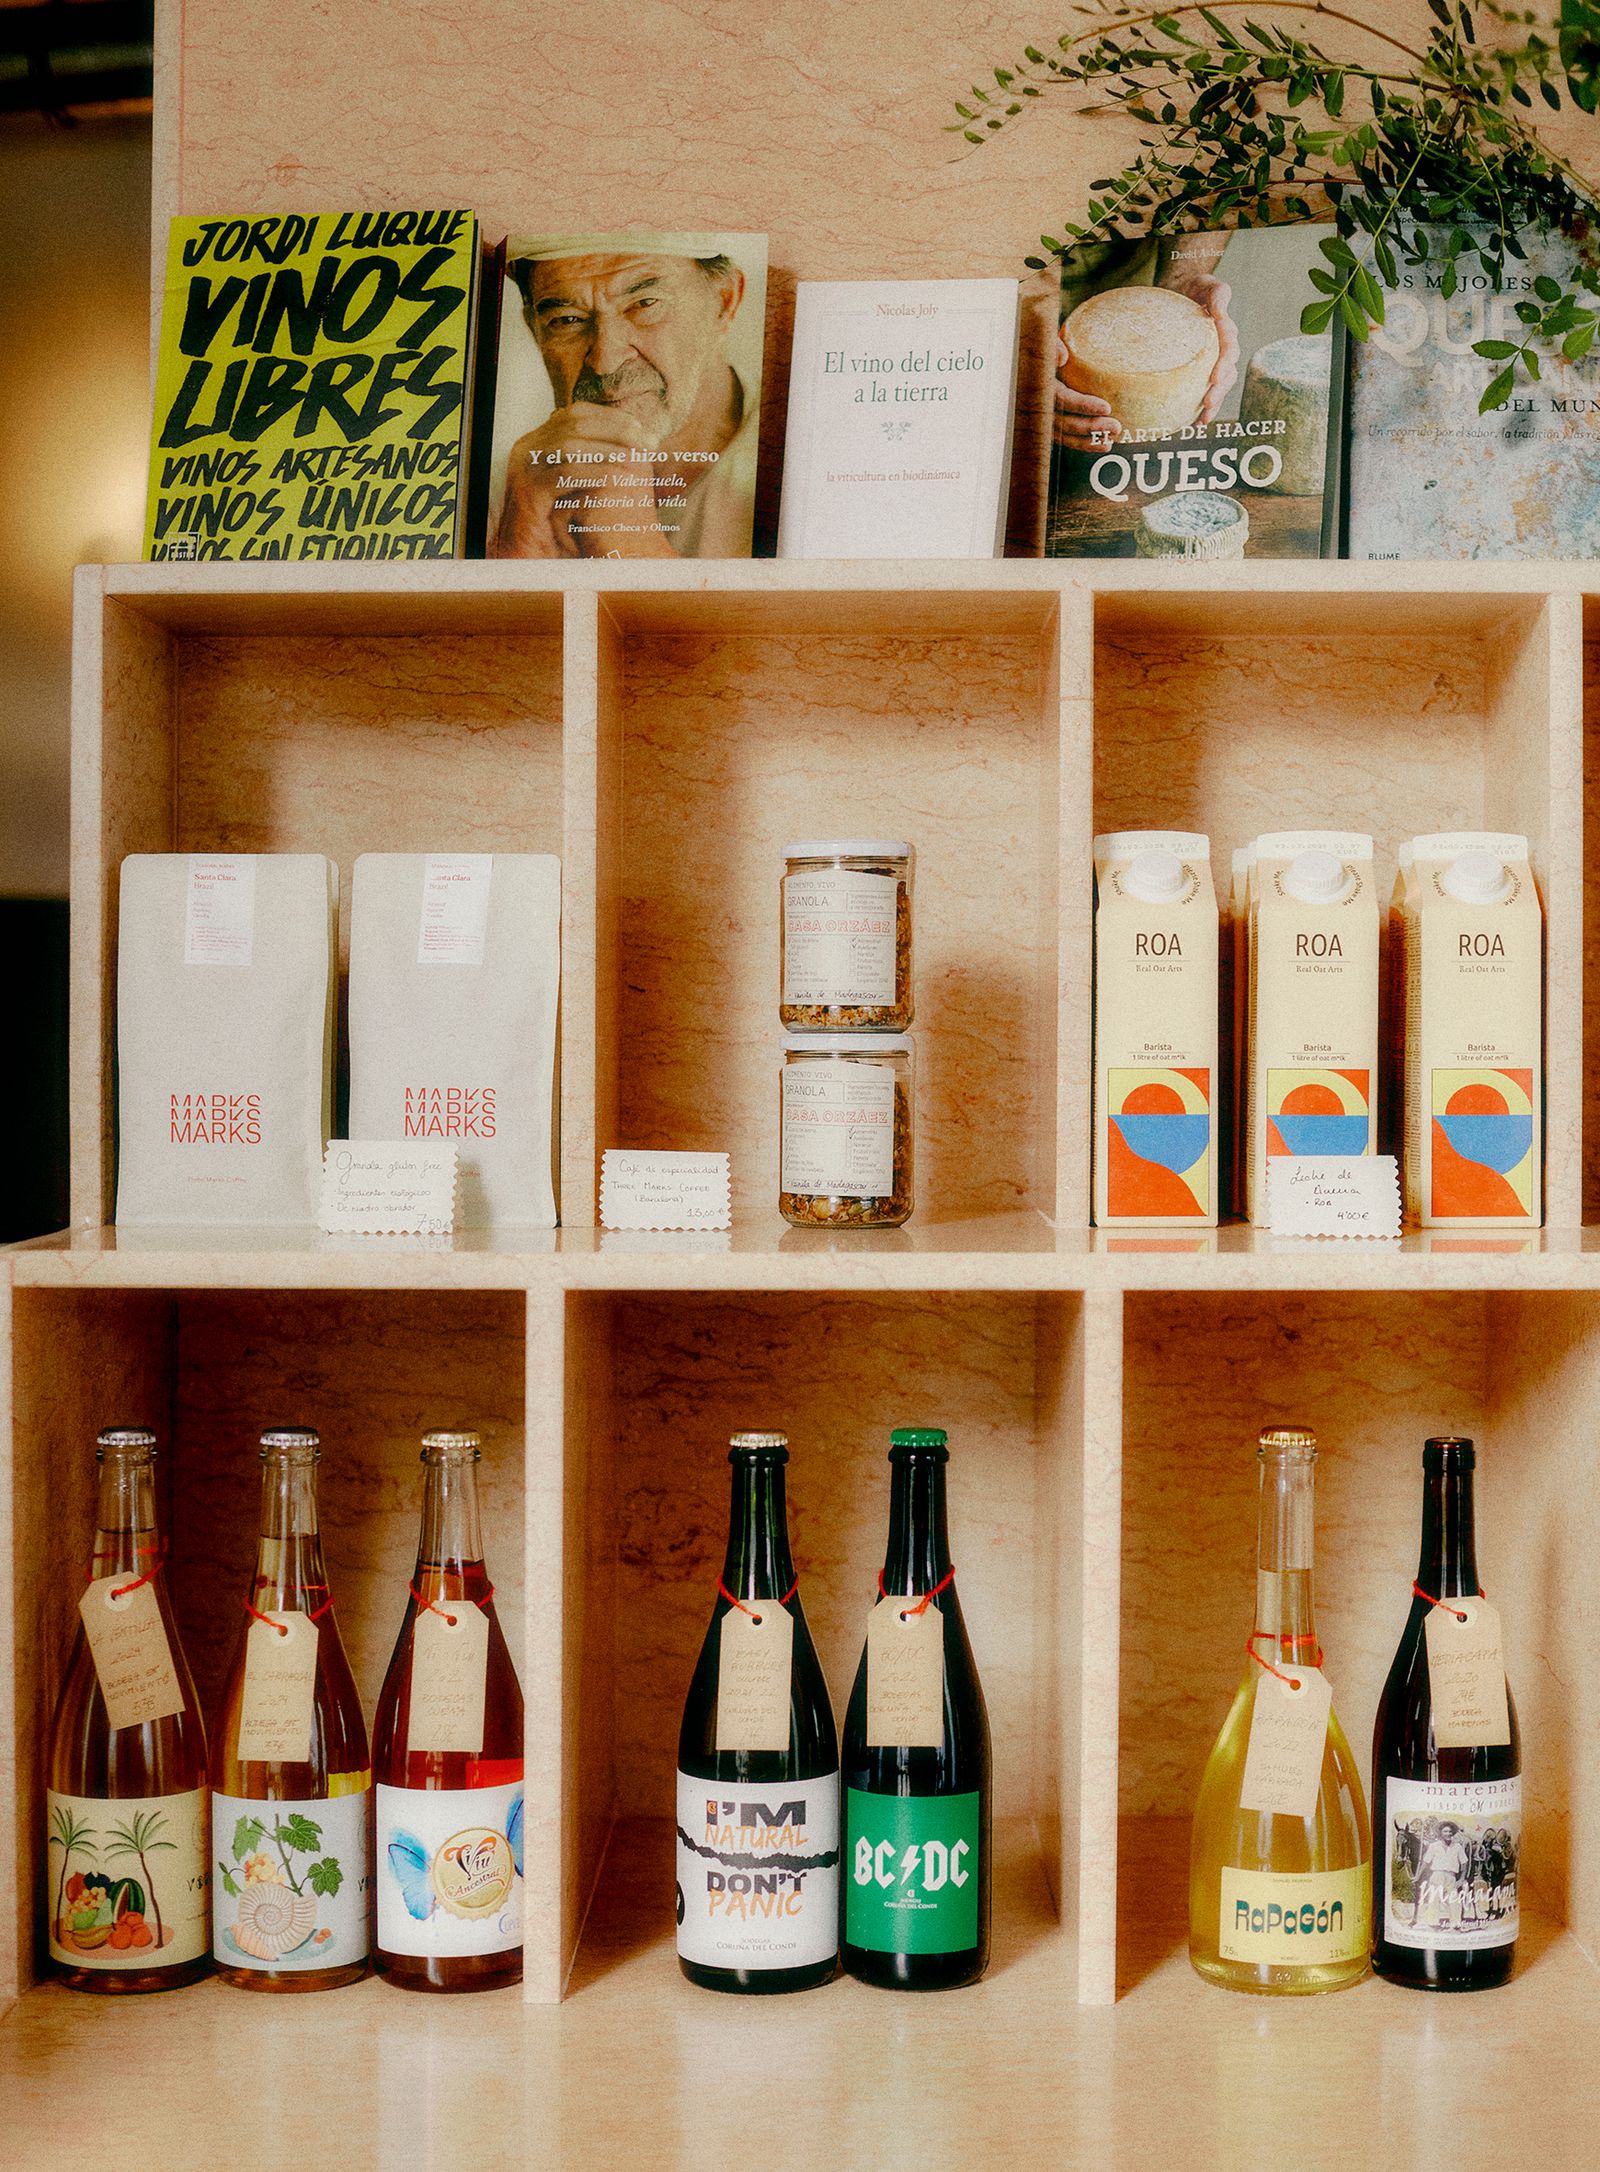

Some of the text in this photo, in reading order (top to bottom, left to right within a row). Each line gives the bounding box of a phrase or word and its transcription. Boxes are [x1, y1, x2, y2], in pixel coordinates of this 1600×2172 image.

[182, 209, 472, 266] JORDI LUQUE
[1171, 250, 1197, 260] David
[179, 247, 466, 357] VINOS
[876, 303, 939, 319] Nicolas Joly
[824, 348, 984, 373] El vino del cielo
[159, 346, 462, 448] LIBRES
[854, 381, 948, 403] a la tierra
[1090, 420, 1287, 446] EL ARTE DE HACER
[1368, 424, 1384, 437] Un
[160, 440, 459, 488] VINOS ARTESANOS
[529, 448, 720, 464] Y el vino se hizo verso
[556, 475, 688, 488] Manuel Valenzuela,
[826, 469, 960, 482] la viticultura en biodinámica
[1089, 445, 1283, 502] QUESO
[154, 478, 456, 539] VINOS ÚNICOS
[554, 495, 687, 509] una historia de vida
[568, 524, 611, 533] Francisco
[650, 523, 681, 532] Olmos
[1368, 552, 1400, 561] BLUME
[194, 873, 237, 881] Santa Clara
[1135, 933, 1182, 957] ROA
[1296, 933, 1343, 957] ROA
[1459, 933, 1505, 957] ROA
[1136, 965, 1182, 973] Real Oat Arts
[1296, 965, 1343, 973] Real Oat Arts
[1459, 965, 1506, 973] Real Oat Arts
[1144, 1043, 1173, 1052] Barista
[1303, 1043, 1332, 1052] Barista
[1467, 1043, 1496, 1052] Barista
[170, 1122, 262, 1144] MARKS
[404, 1115, 497, 1138] MARKS
[420, 1160, 442, 1178] free
[704, 1822, 810, 1850] NATURAL
[706, 1870, 808, 1896] DON'T
[708, 1887, 805, 1922] PANIC
